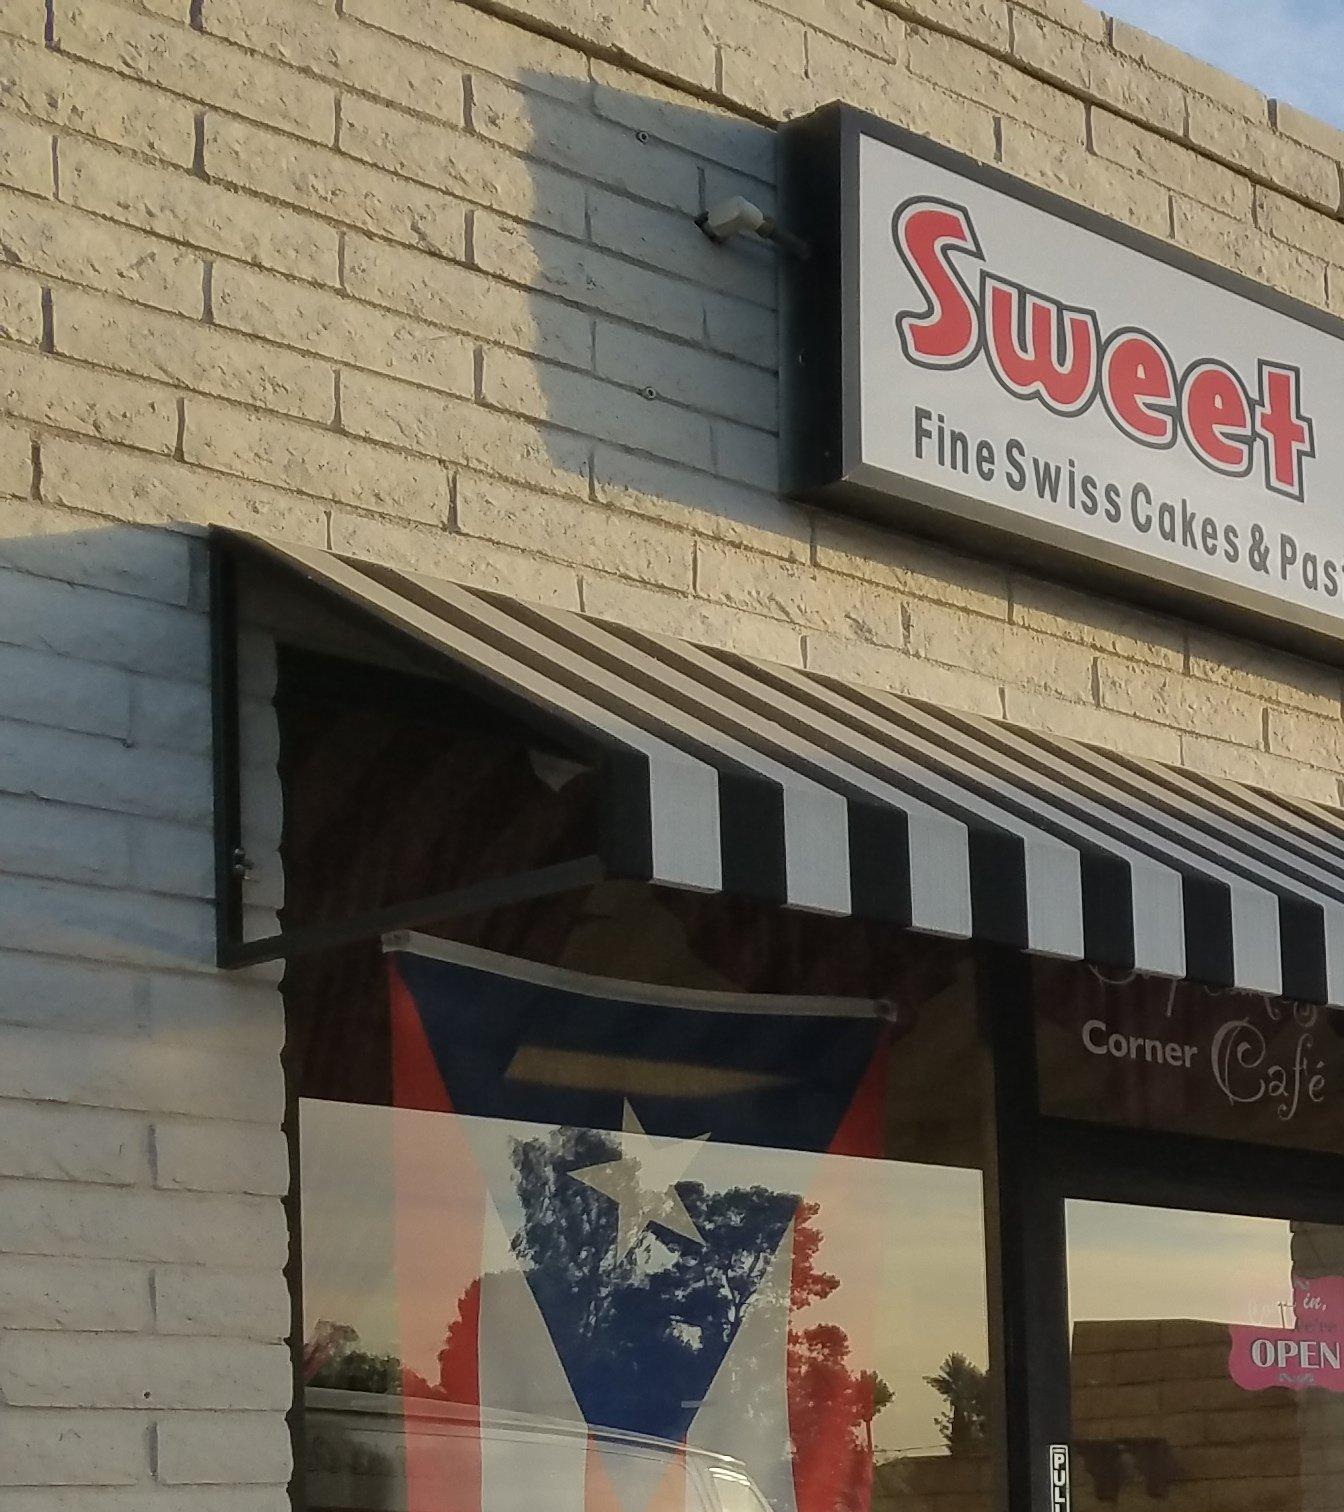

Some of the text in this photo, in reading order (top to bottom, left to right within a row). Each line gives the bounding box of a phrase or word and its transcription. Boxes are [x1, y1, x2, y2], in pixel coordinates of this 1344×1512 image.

[892, 195, 1315, 502] Sweet
[915, 406, 995, 481] Fine
[1006, 438, 1121, 523] Swiss
[1131, 483, 1239, 563] Cakes
[1248, 524, 1270, 574] &
[1081, 1016, 1327, 1120] Corner Café
[1251, 1339, 1341, 1369] OPEN
